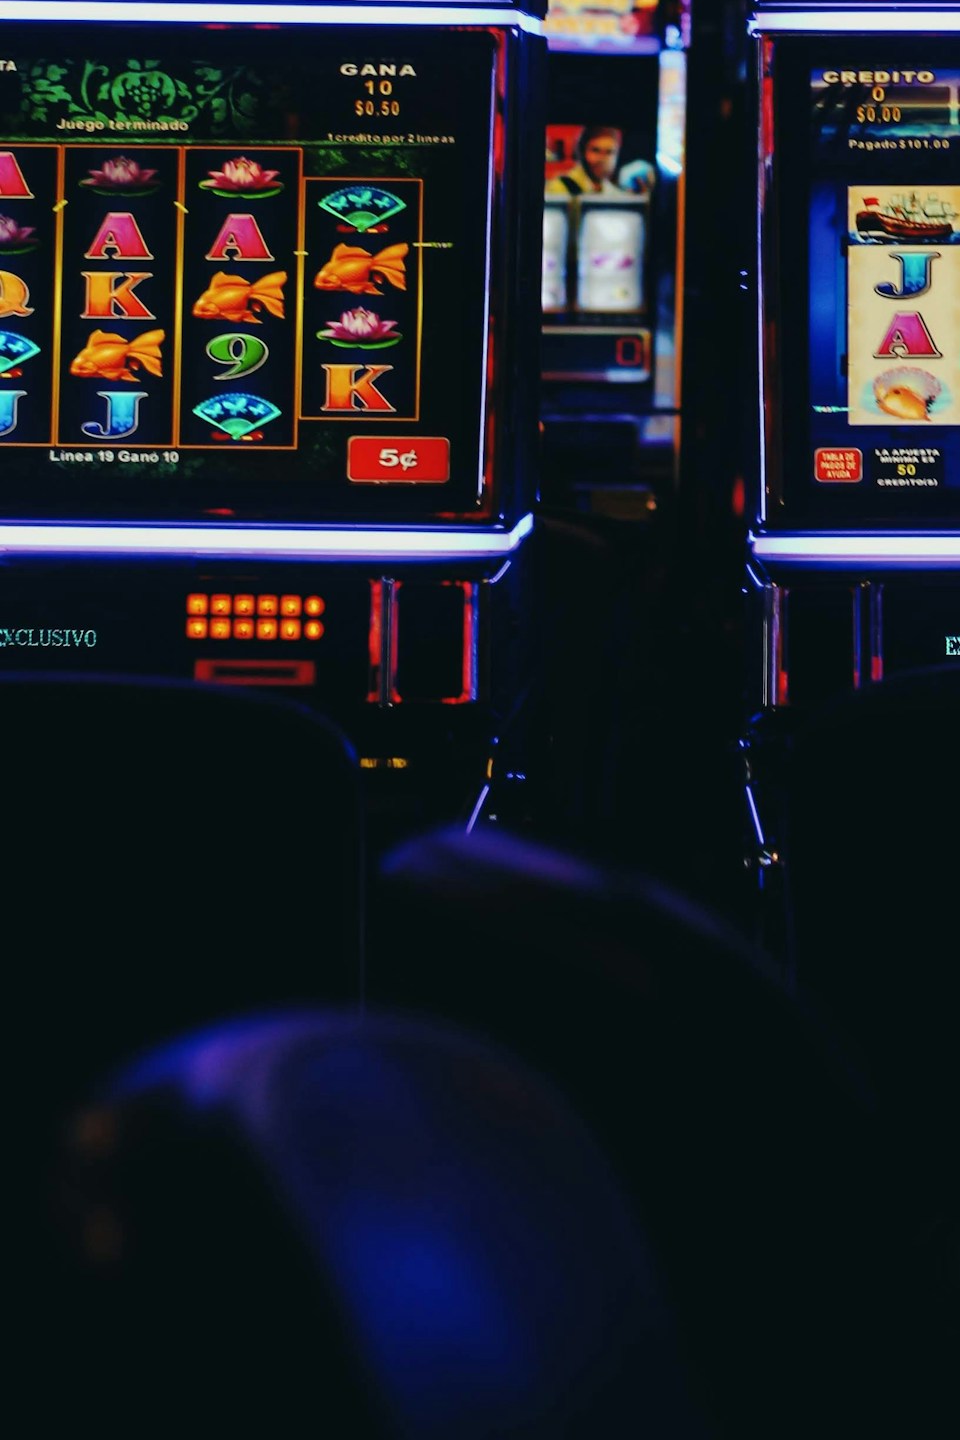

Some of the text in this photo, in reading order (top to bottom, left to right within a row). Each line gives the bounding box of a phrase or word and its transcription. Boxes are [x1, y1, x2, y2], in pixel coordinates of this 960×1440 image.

[340, 63, 417, 77] GANA
[822, 70, 936, 85] CREDITO
[364, 80, 393, 96] 10
[871, 85, 885, 103] 0
[354, 100, 400, 116] $0.50
[856, 106, 902, 123] $0.00
[56, 118, 190, 132] Juego terminado
[382, 135, 405, 144] por
[407, 133, 415, 143] 2
[848, 139, 898, 151] Pagado
[84, 212, 155, 261] A
[205, 213, 276, 262] A
[873, 250, 941, 299] J
[80, 271, 158, 321] K
[873, 311, 943, 359] A
[205, 332, 269, 381] 9
[319, 363, 398, 413] K
[81, 390, 150, 440] J
[97, 450, 115, 462] 19
[162, 451, 180, 463] 10
[377, 448, 419, 472] 5¢
[822, 452, 845, 461] TABLA
[874, 448, 941, 457] LA APUESTA
[826, 469, 852, 479] AYUDA
[897, 464, 917, 476] 50
